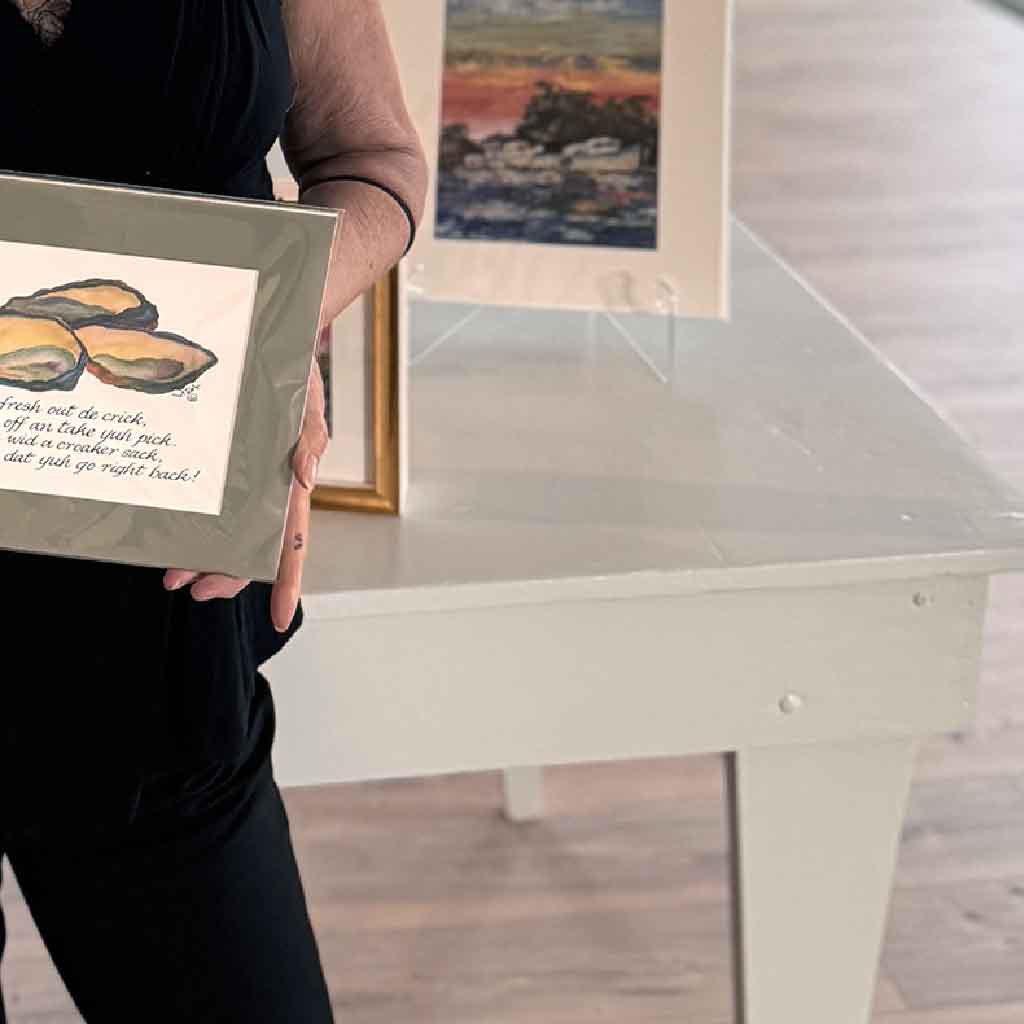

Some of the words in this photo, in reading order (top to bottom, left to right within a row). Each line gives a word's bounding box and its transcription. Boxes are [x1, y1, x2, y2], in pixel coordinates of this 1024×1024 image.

[47, 405, 78, 418] out
[78, 406, 98, 420] de
[3, 416, 30, 432] off
[29, 421, 53, 433] an
[57, 422, 96, 437] take
[95, 428, 132, 447] yuh
[7, 434, 39, 447] wid
[40, 439, 54, 449] a
[56, 440, 120, 456] croaker
[3, 450, 35, 463] dat
[34, 453, 71, 470] yuh
[73, 460, 96, 474] go
[100, 463, 145, 478] right
[148, 466, 201, 483] back!
